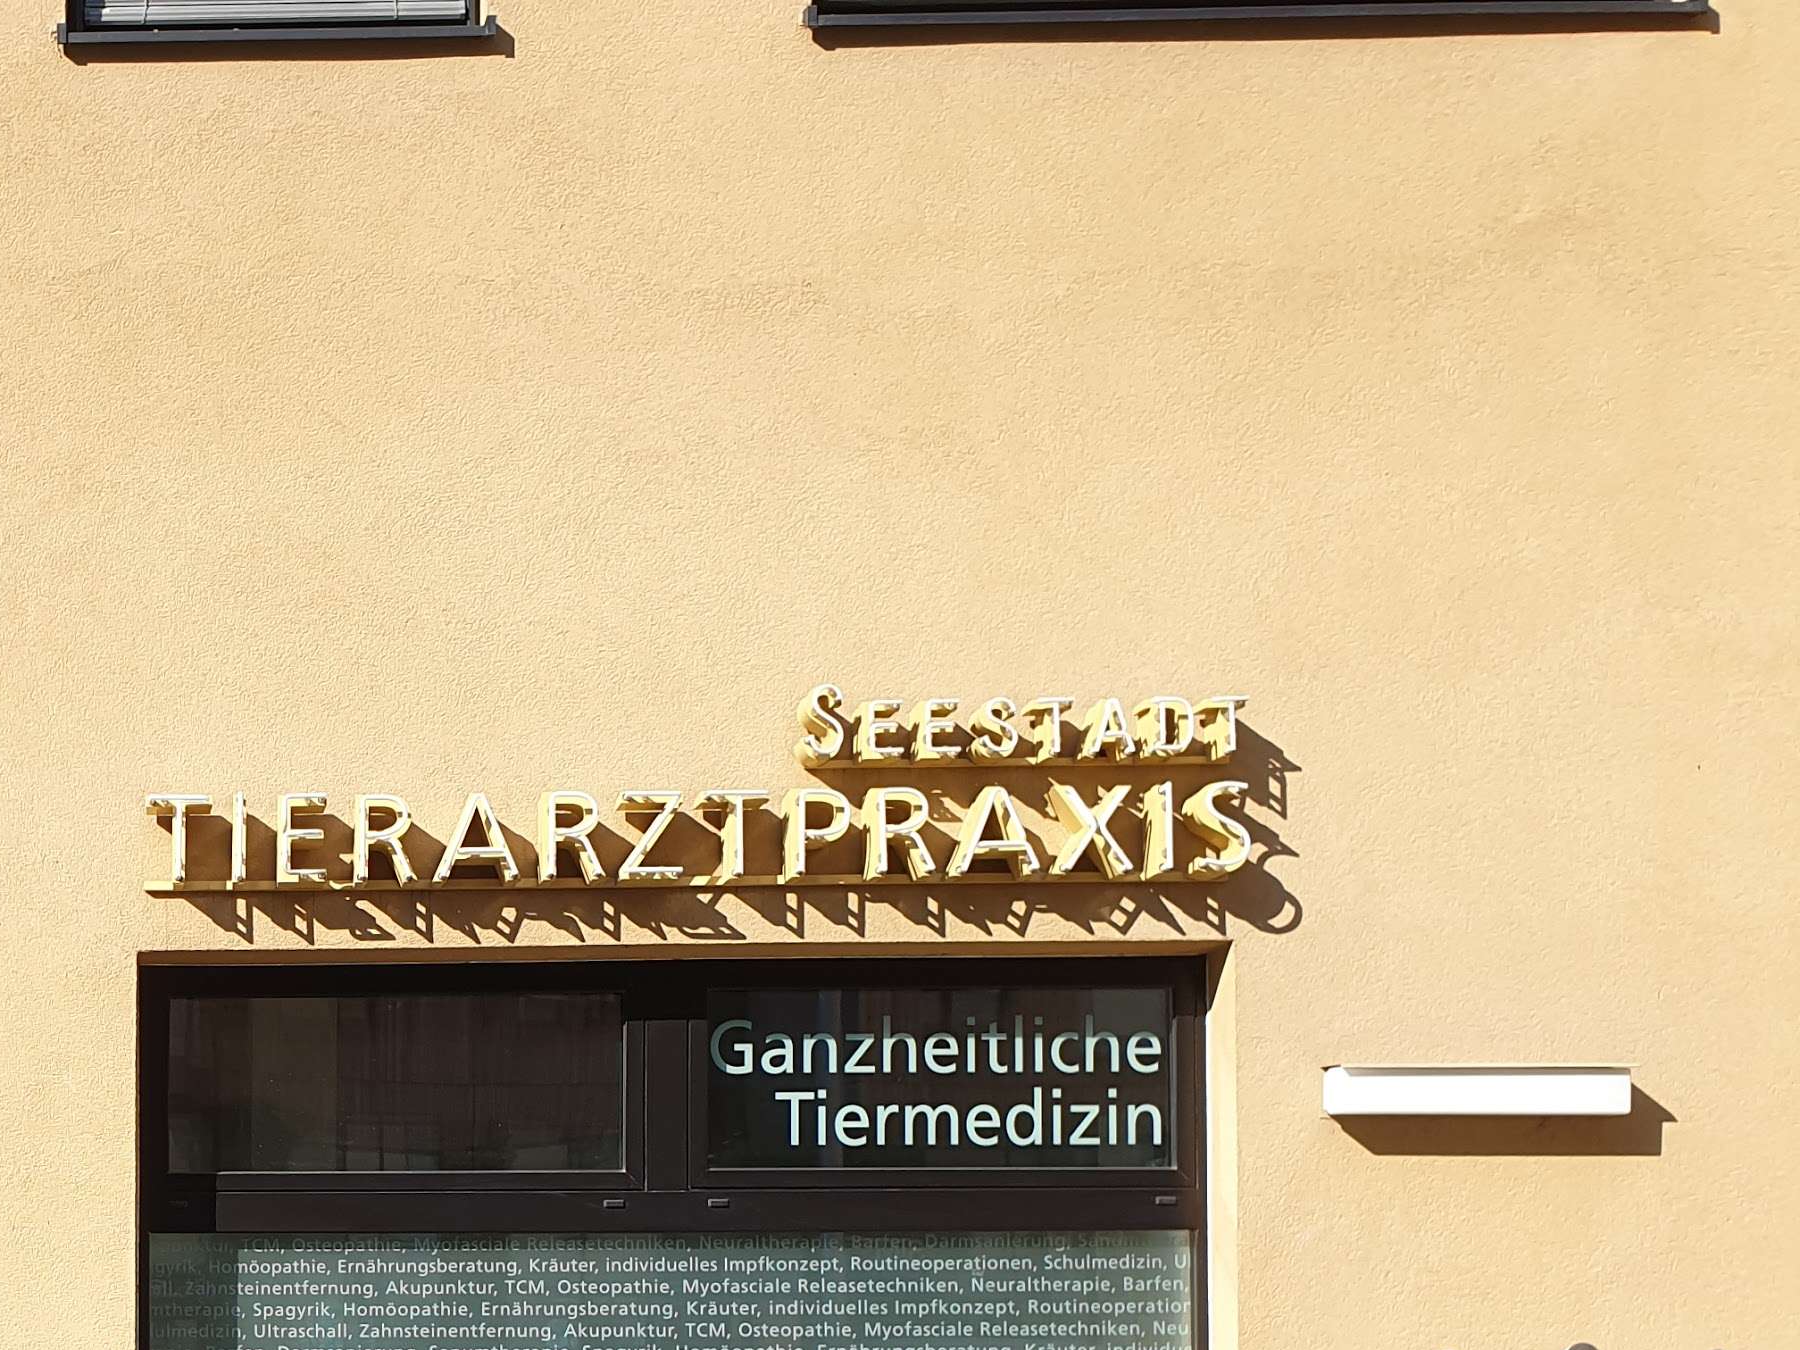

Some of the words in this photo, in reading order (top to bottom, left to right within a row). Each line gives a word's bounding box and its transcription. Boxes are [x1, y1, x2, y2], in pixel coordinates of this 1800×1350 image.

[797, 683, 1249, 764] SEESTADT
[145, 779, 1251, 884] TIERARZTPRAXIS
[710, 1016, 1163, 1075] Ganzheitliche
[776, 1089, 1163, 1148] Tiermedizin
[339, 1258, 521, 1276] Ernährungsberatung,
[530, 1257, 598, 1275] Kräuter,
[607, 1257, 717, 1272] individuelles
[725, 1256, 843, 1274] Impfkonzept,
[852, 1255, 1036, 1273] Routineoperationen,
[1045, 1254, 1166, 1272] Schulmedizin,
[386, 1280, 497, 1298] Akupunktur,
[505, 1278, 549, 1296] TCM,
[558, 1279, 674, 1297] Osteopathie,
[683, 1278, 790, 1296] Myofasciale
[799, 1278, 963, 1296] Releasetechniken,
[972, 1277, 1115, 1295] Neuraltherapie,
[1124, 1276, 1189, 1294] Barfen,
[254, 1303, 335, 1321] Spagyrik,
[344, 1302, 472, 1320] Homöopathie,
[482, 1301, 678, 1319] Ernährungsberatung,
[687, 1300, 760, 1318] Kräuter,
[770, 1300, 887, 1315] individuelles
[896, 1299, 1019, 1317] Impfkonzept,
[255, 1324, 352, 1342] Ultraschall,
[360, 1323, 556, 1341] Zahnsteinentfernung,
[564, 1322, 677, 1340] Akupunktur,
[685, 1320, 730, 1338] TCM,
[739, 1322, 856, 1340] Osteopathie,
[865, 1321, 972, 1339] Myofasciale
[981, 1321, 1144, 1339] Releasetechniken,
